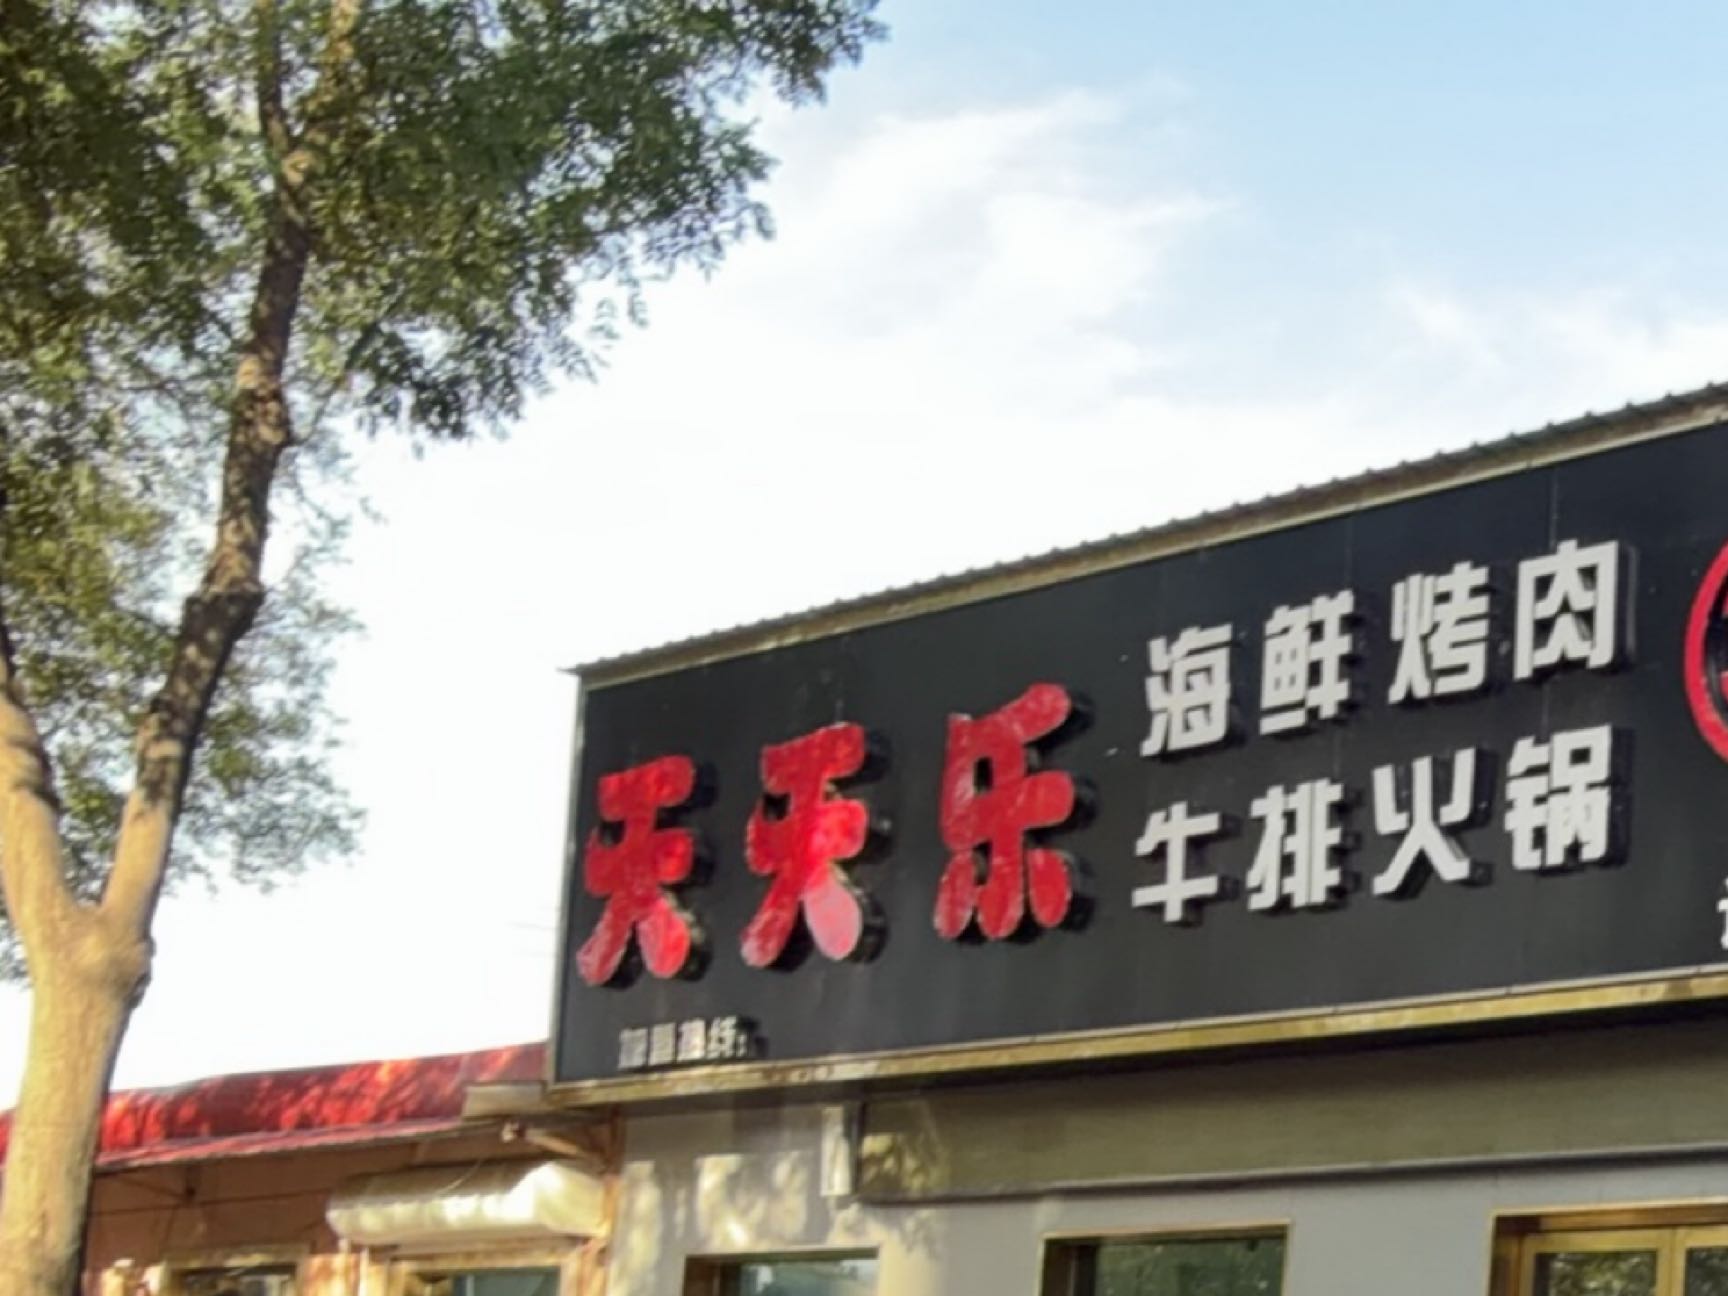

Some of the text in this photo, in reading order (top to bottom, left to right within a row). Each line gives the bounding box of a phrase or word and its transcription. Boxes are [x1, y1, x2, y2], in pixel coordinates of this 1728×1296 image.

[1139, 539, 1619, 757] 海鲜烤肉
[576, 683, 1075, 986] 天天乐
[1131, 724, 1613, 923] 牛排火锅
